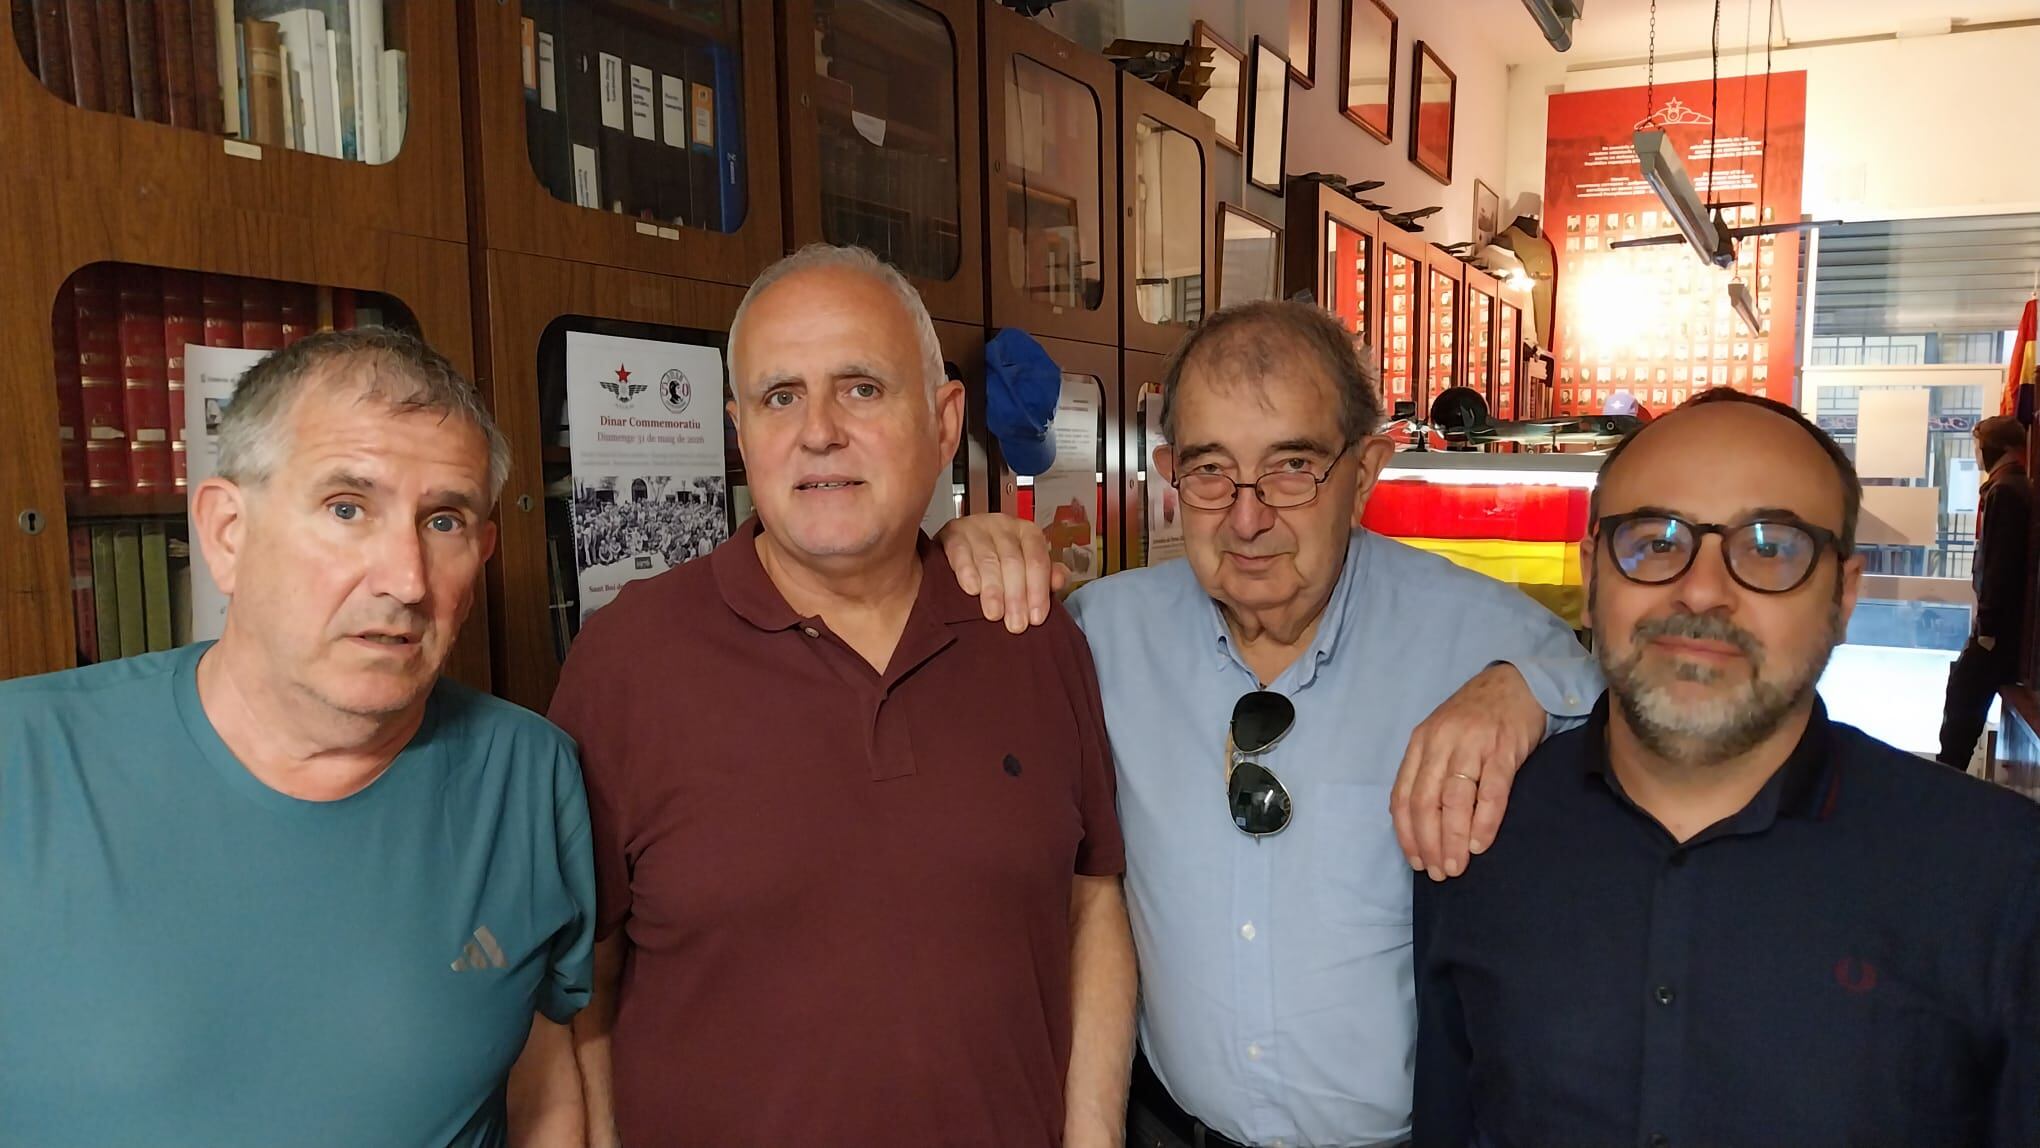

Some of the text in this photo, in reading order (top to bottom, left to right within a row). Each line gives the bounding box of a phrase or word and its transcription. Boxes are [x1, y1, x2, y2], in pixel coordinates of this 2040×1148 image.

[600, 415, 701, 429] Dinar Commemoratiu
[646, 433, 656, 443] de
[676, 435, 686, 443] de
